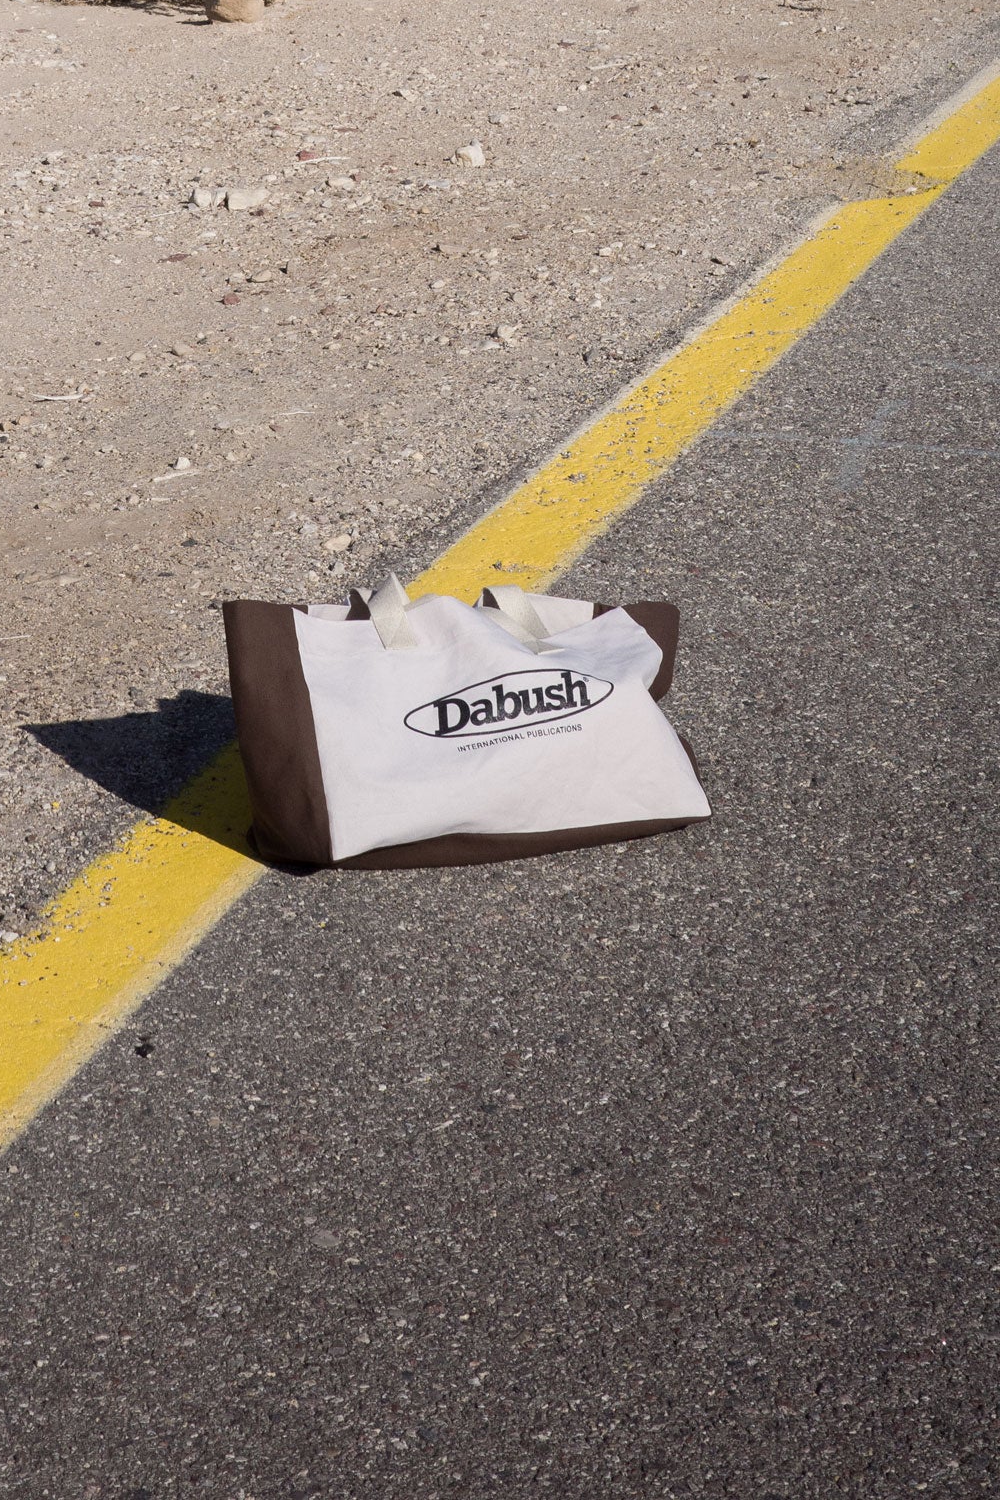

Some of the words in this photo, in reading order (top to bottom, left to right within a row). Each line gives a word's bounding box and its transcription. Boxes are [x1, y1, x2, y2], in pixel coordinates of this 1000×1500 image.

[433, 671, 590, 736] Dabush
[457, 733, 525, 752] INTERNATIONAL
[526, 723, 583, 739] PUBLICATIONS
